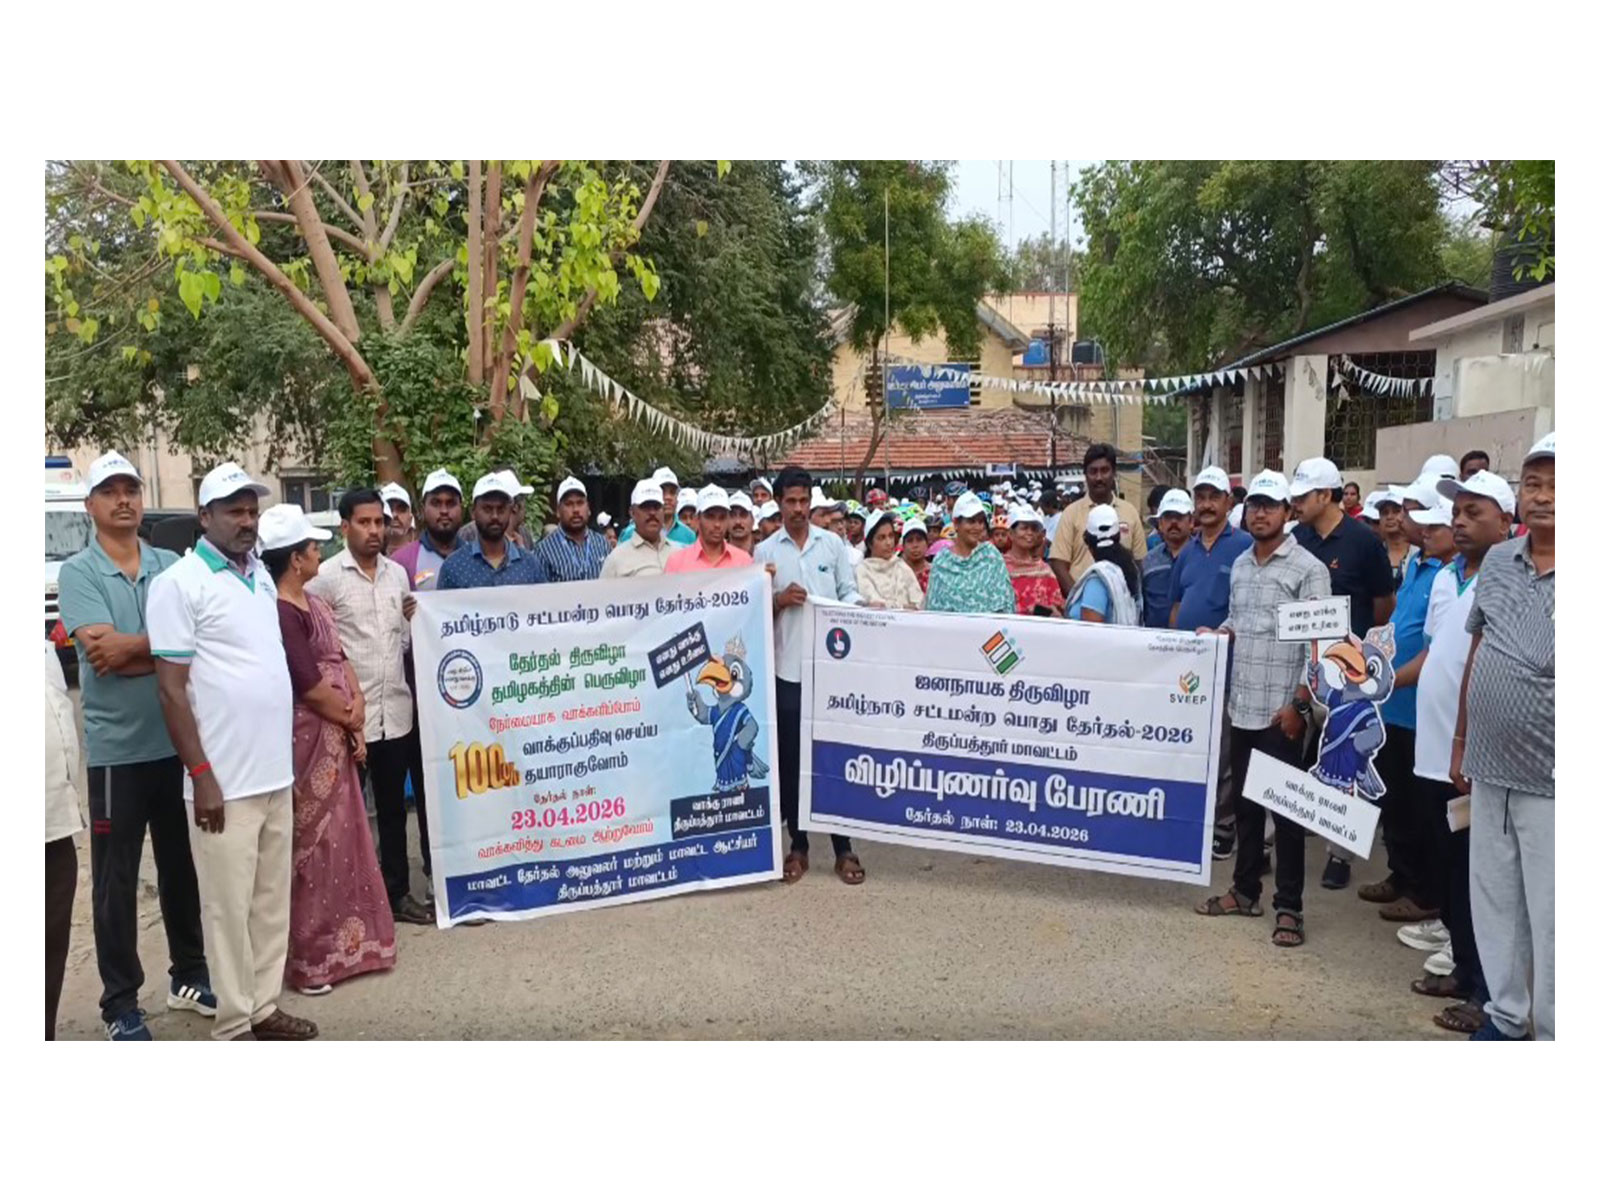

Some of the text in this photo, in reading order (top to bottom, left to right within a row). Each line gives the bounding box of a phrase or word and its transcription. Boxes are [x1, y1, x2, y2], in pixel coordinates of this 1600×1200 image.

[441, 590, 749, 639] தமிழ்நாடு சட்டமன்ற பொது தேர்தல்-2026
[509, 648, 561, 675] தேர்தல்
[569, 643, 626, 669] திருவிழா
[491, 666, 646, 706] தமிழகத்தின் பெருவிழா
[915, 674, 1091, 710] ஜனநாயக திருவிழா
[1170, 693, 1207, 705] SVEEP
[489, 697, 641, 735] நேர்மையாக வாக்களிப்போம்
[827, 693, 1193, 744] தமிழ்நாடு சட்டமன்ற பொது தேர்தல்-2026
[523, 722, 658, 756] வாக்குப்பதிவு செய்ய
[922, 730, 1078, 762] திருப்பத்தூர் மாவட்டம்
[449, 741, 520, 800] 100%
[525, 751, 629, 785] தயாராகுவோம்
[533, 788, 567, 805] தேர்தல்
[692, 792, 745, 811] வாக்கு ராணி
[844, 753, 1166, 820] விழிப்புணர்வு பேரணி
[511, 796, 626, 831] 23.04.2026
[673, 804, 765, 833] திருப்பத்தூர் மாவட்டம்
[905, 806, 1089, 843] தேர்தல் நாள்: 23.04.2026
[477, 818, 654, 860] வாக்களித்து கடமை ஆற்றுவோம்
[467, 832, 757, 891] மாவட்ட தேர்தல் அலுவலர் மற்றும் மாவட்ட ஆட்சியர்
[557, 865, 678, 901] திருப்பத்தூர் மாவட்டம்
